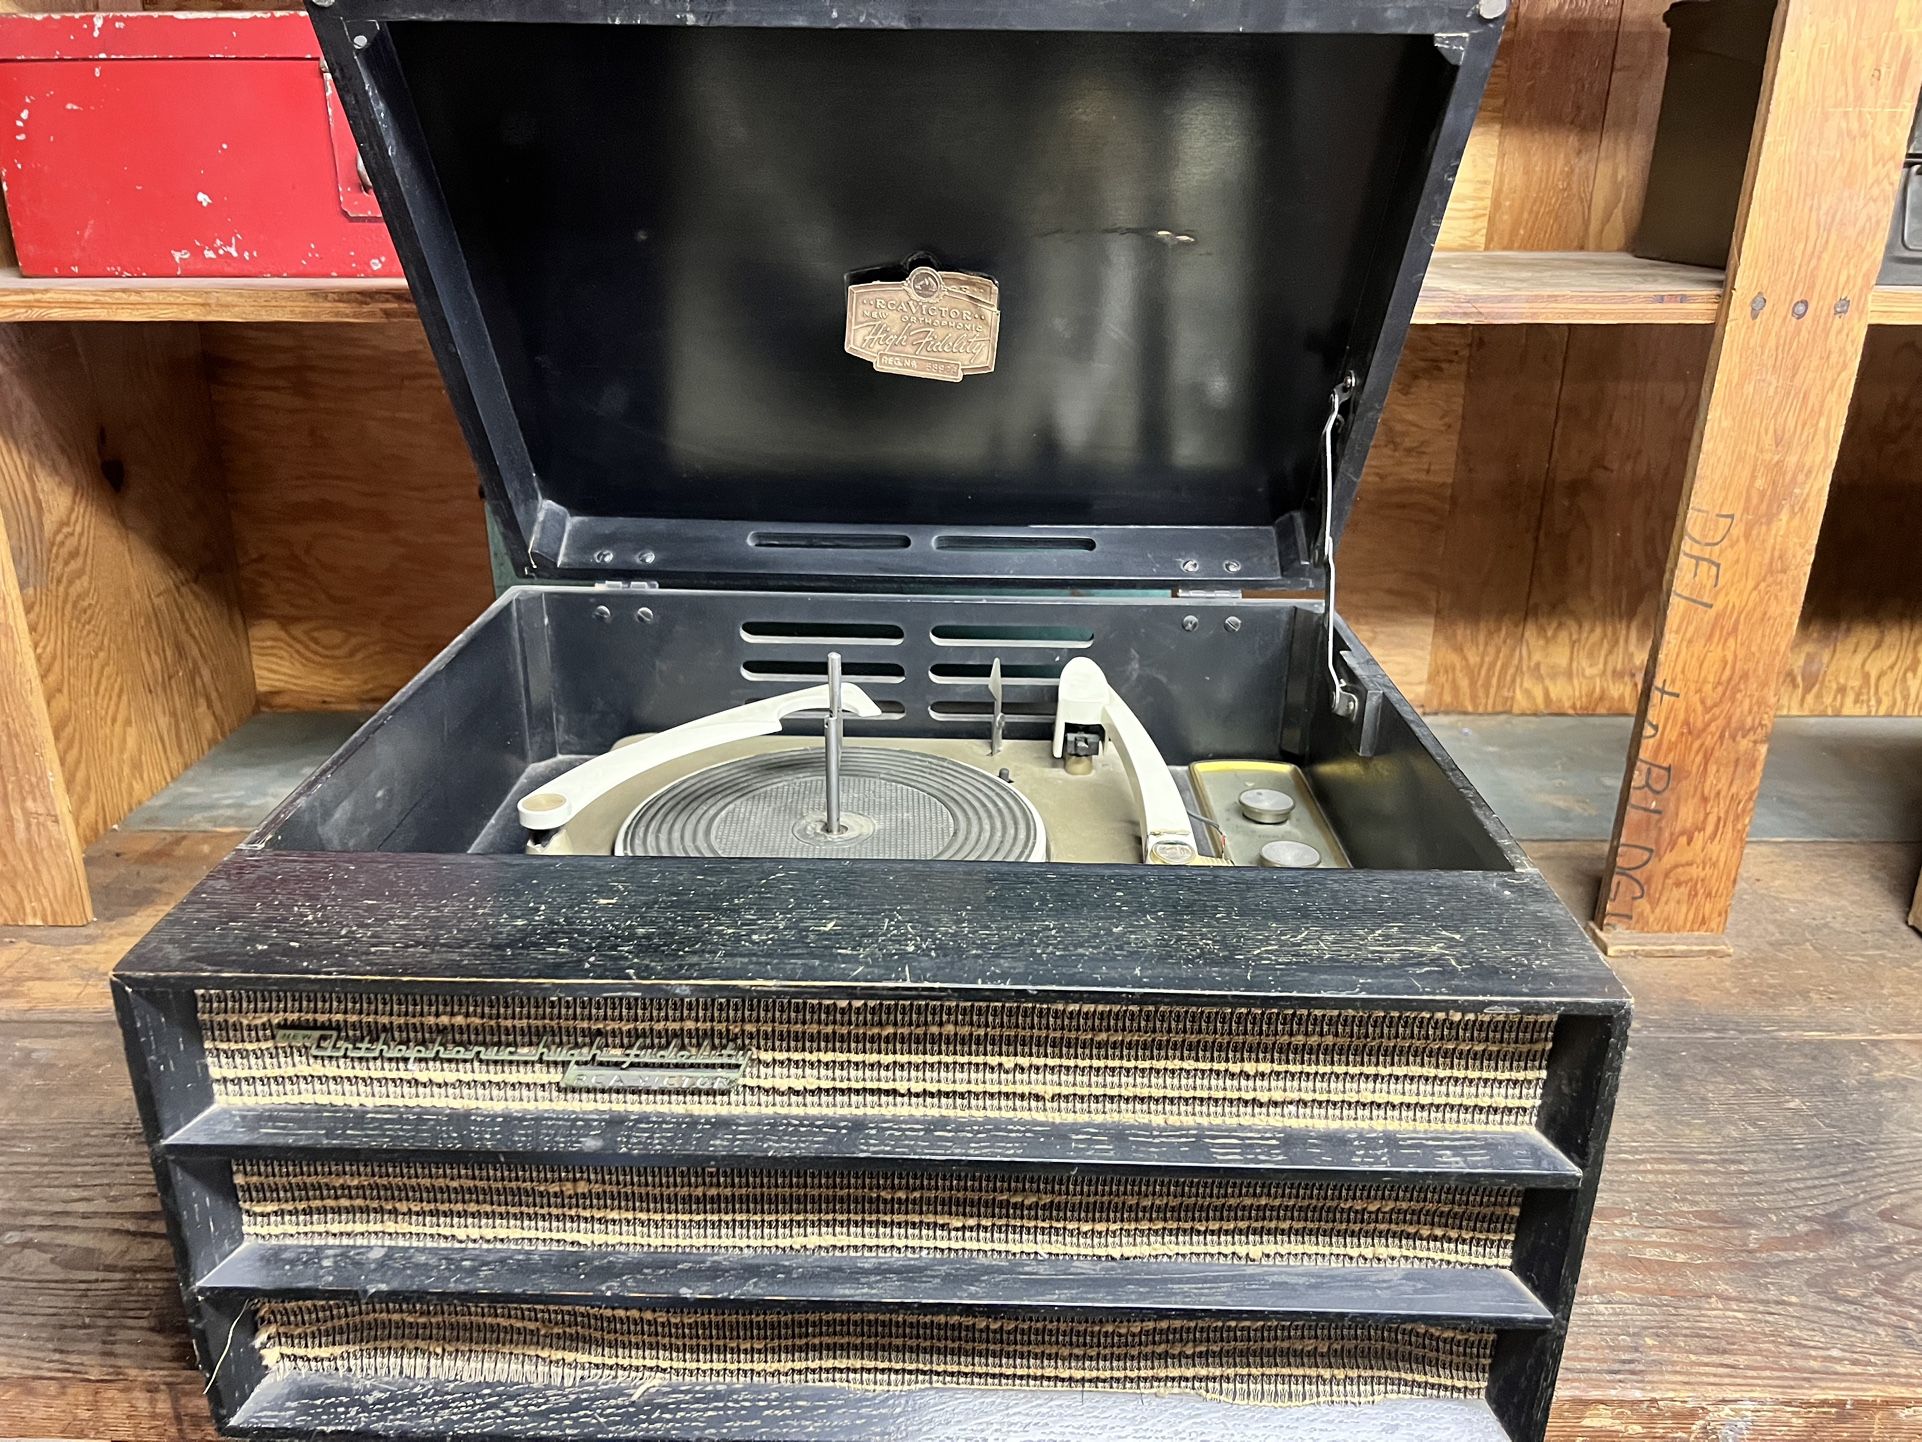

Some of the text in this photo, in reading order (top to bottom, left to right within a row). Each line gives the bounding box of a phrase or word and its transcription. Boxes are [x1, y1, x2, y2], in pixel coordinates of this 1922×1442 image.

[876, 299, 973, 320] RCA VICTOR
[862, 310, 983, 332] NEW ORTHOPHONIC
[853, 321, 991, 363] High Fidelity
[574, 1073, 731, 1088] RCA VICTOR
